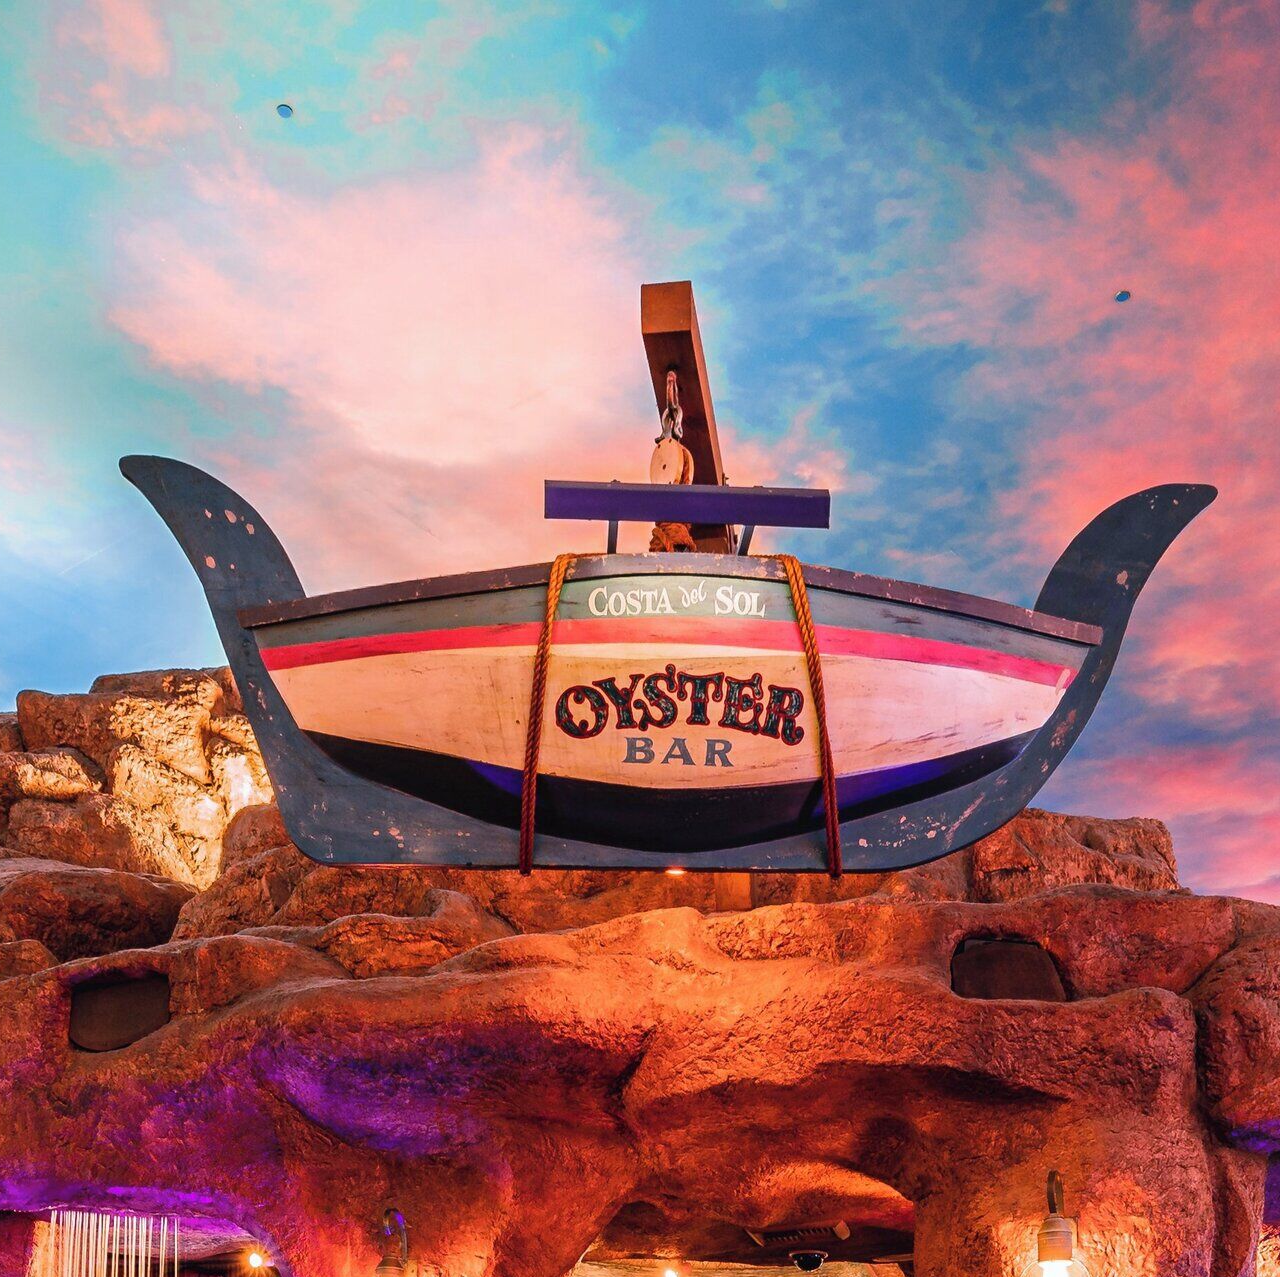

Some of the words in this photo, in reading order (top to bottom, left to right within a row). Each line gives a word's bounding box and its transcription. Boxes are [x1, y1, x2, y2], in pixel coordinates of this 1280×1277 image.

[588, 586, 677, 616] COSTA
[679, 580, 707, 608] del
[714, 585, 766, 617] SOL
[555, 664, 805, 746] OYSTER
[622, 737, 735, 767] BAR
